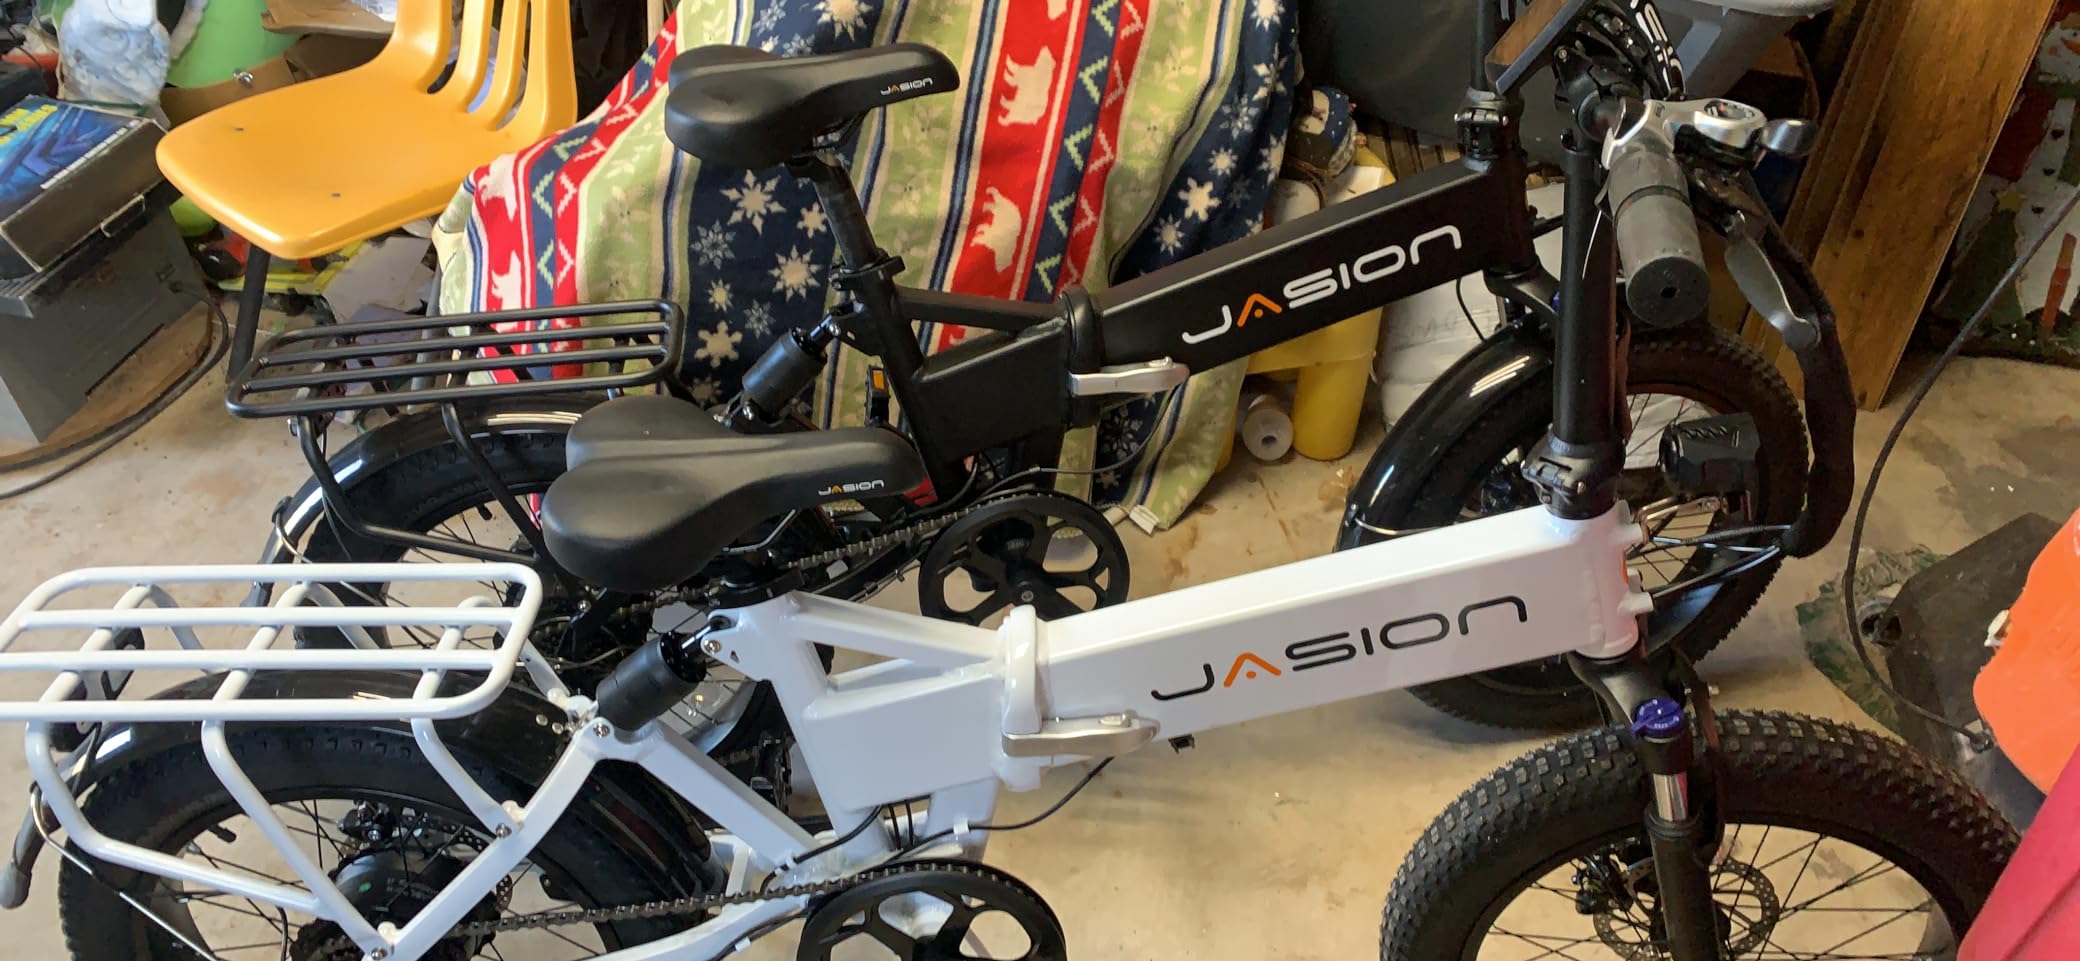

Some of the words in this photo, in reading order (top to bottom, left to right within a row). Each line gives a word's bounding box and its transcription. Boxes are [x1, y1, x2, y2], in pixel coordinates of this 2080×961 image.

[880, 77, 933, 96] JASION
[1181, 224, 1462, 345] JASION
[818, 479, 885, 496] JASION
[1150, 595, 1528, 701] JASION
